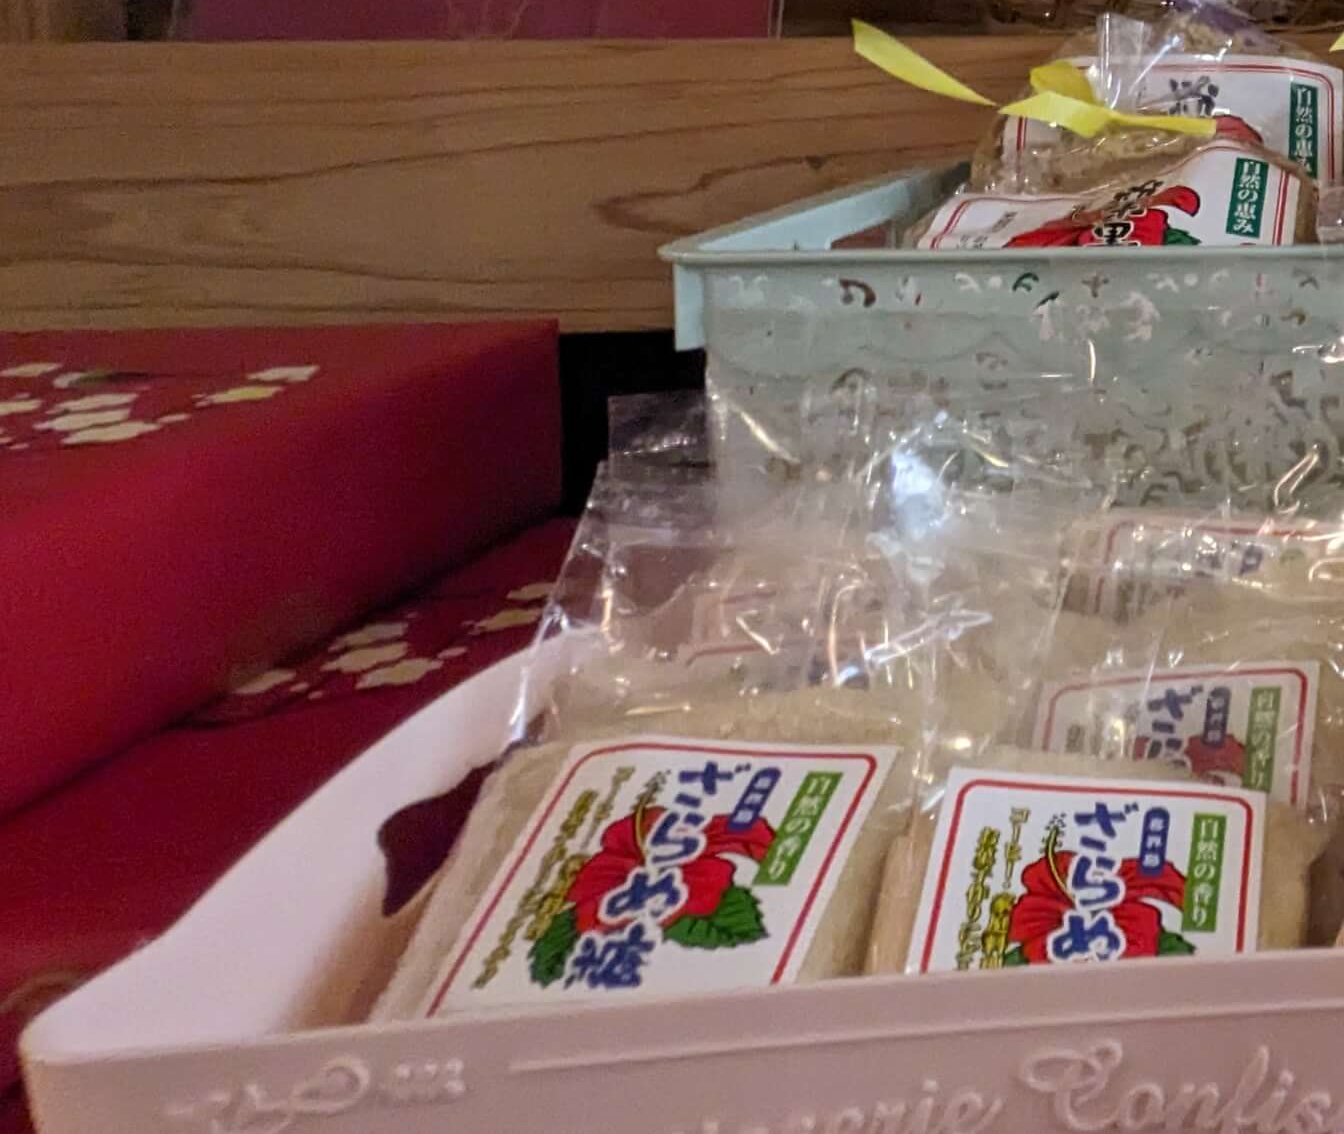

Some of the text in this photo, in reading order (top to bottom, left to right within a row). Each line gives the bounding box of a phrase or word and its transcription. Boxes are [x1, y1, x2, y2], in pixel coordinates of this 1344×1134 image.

[1233, 160, 1267, 234] 自然の恵み
[563, 760, 753, 990] ざらめ糖
[1051, 801, 1140, 961] ざらめ
[1192, 819, 1220, 928] 自然の香り
